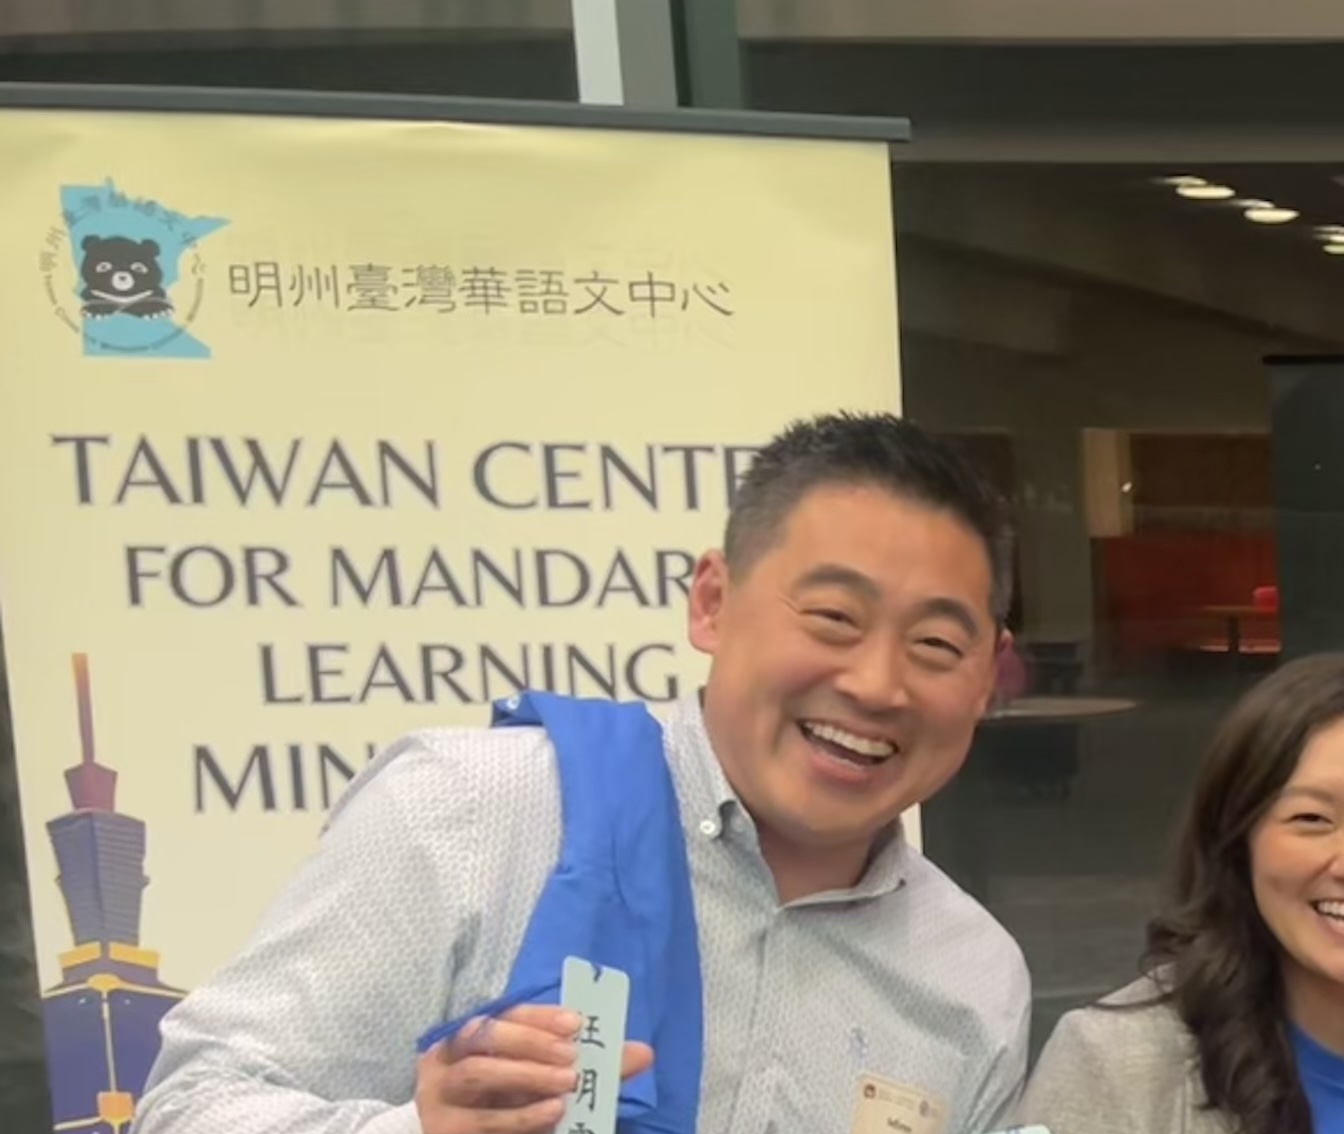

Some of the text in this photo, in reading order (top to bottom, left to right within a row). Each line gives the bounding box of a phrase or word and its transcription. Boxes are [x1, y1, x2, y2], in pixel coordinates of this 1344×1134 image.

[227, 261, 736, 318] 明州臺灣華語文中心
[50, 433, 757, 511] TAIWAN CENTE
[124, 545, 696, 610] FOR MANDAR
[257, 641, 681, 705] LEARNING
[192, 743, 378, 813] MIN
